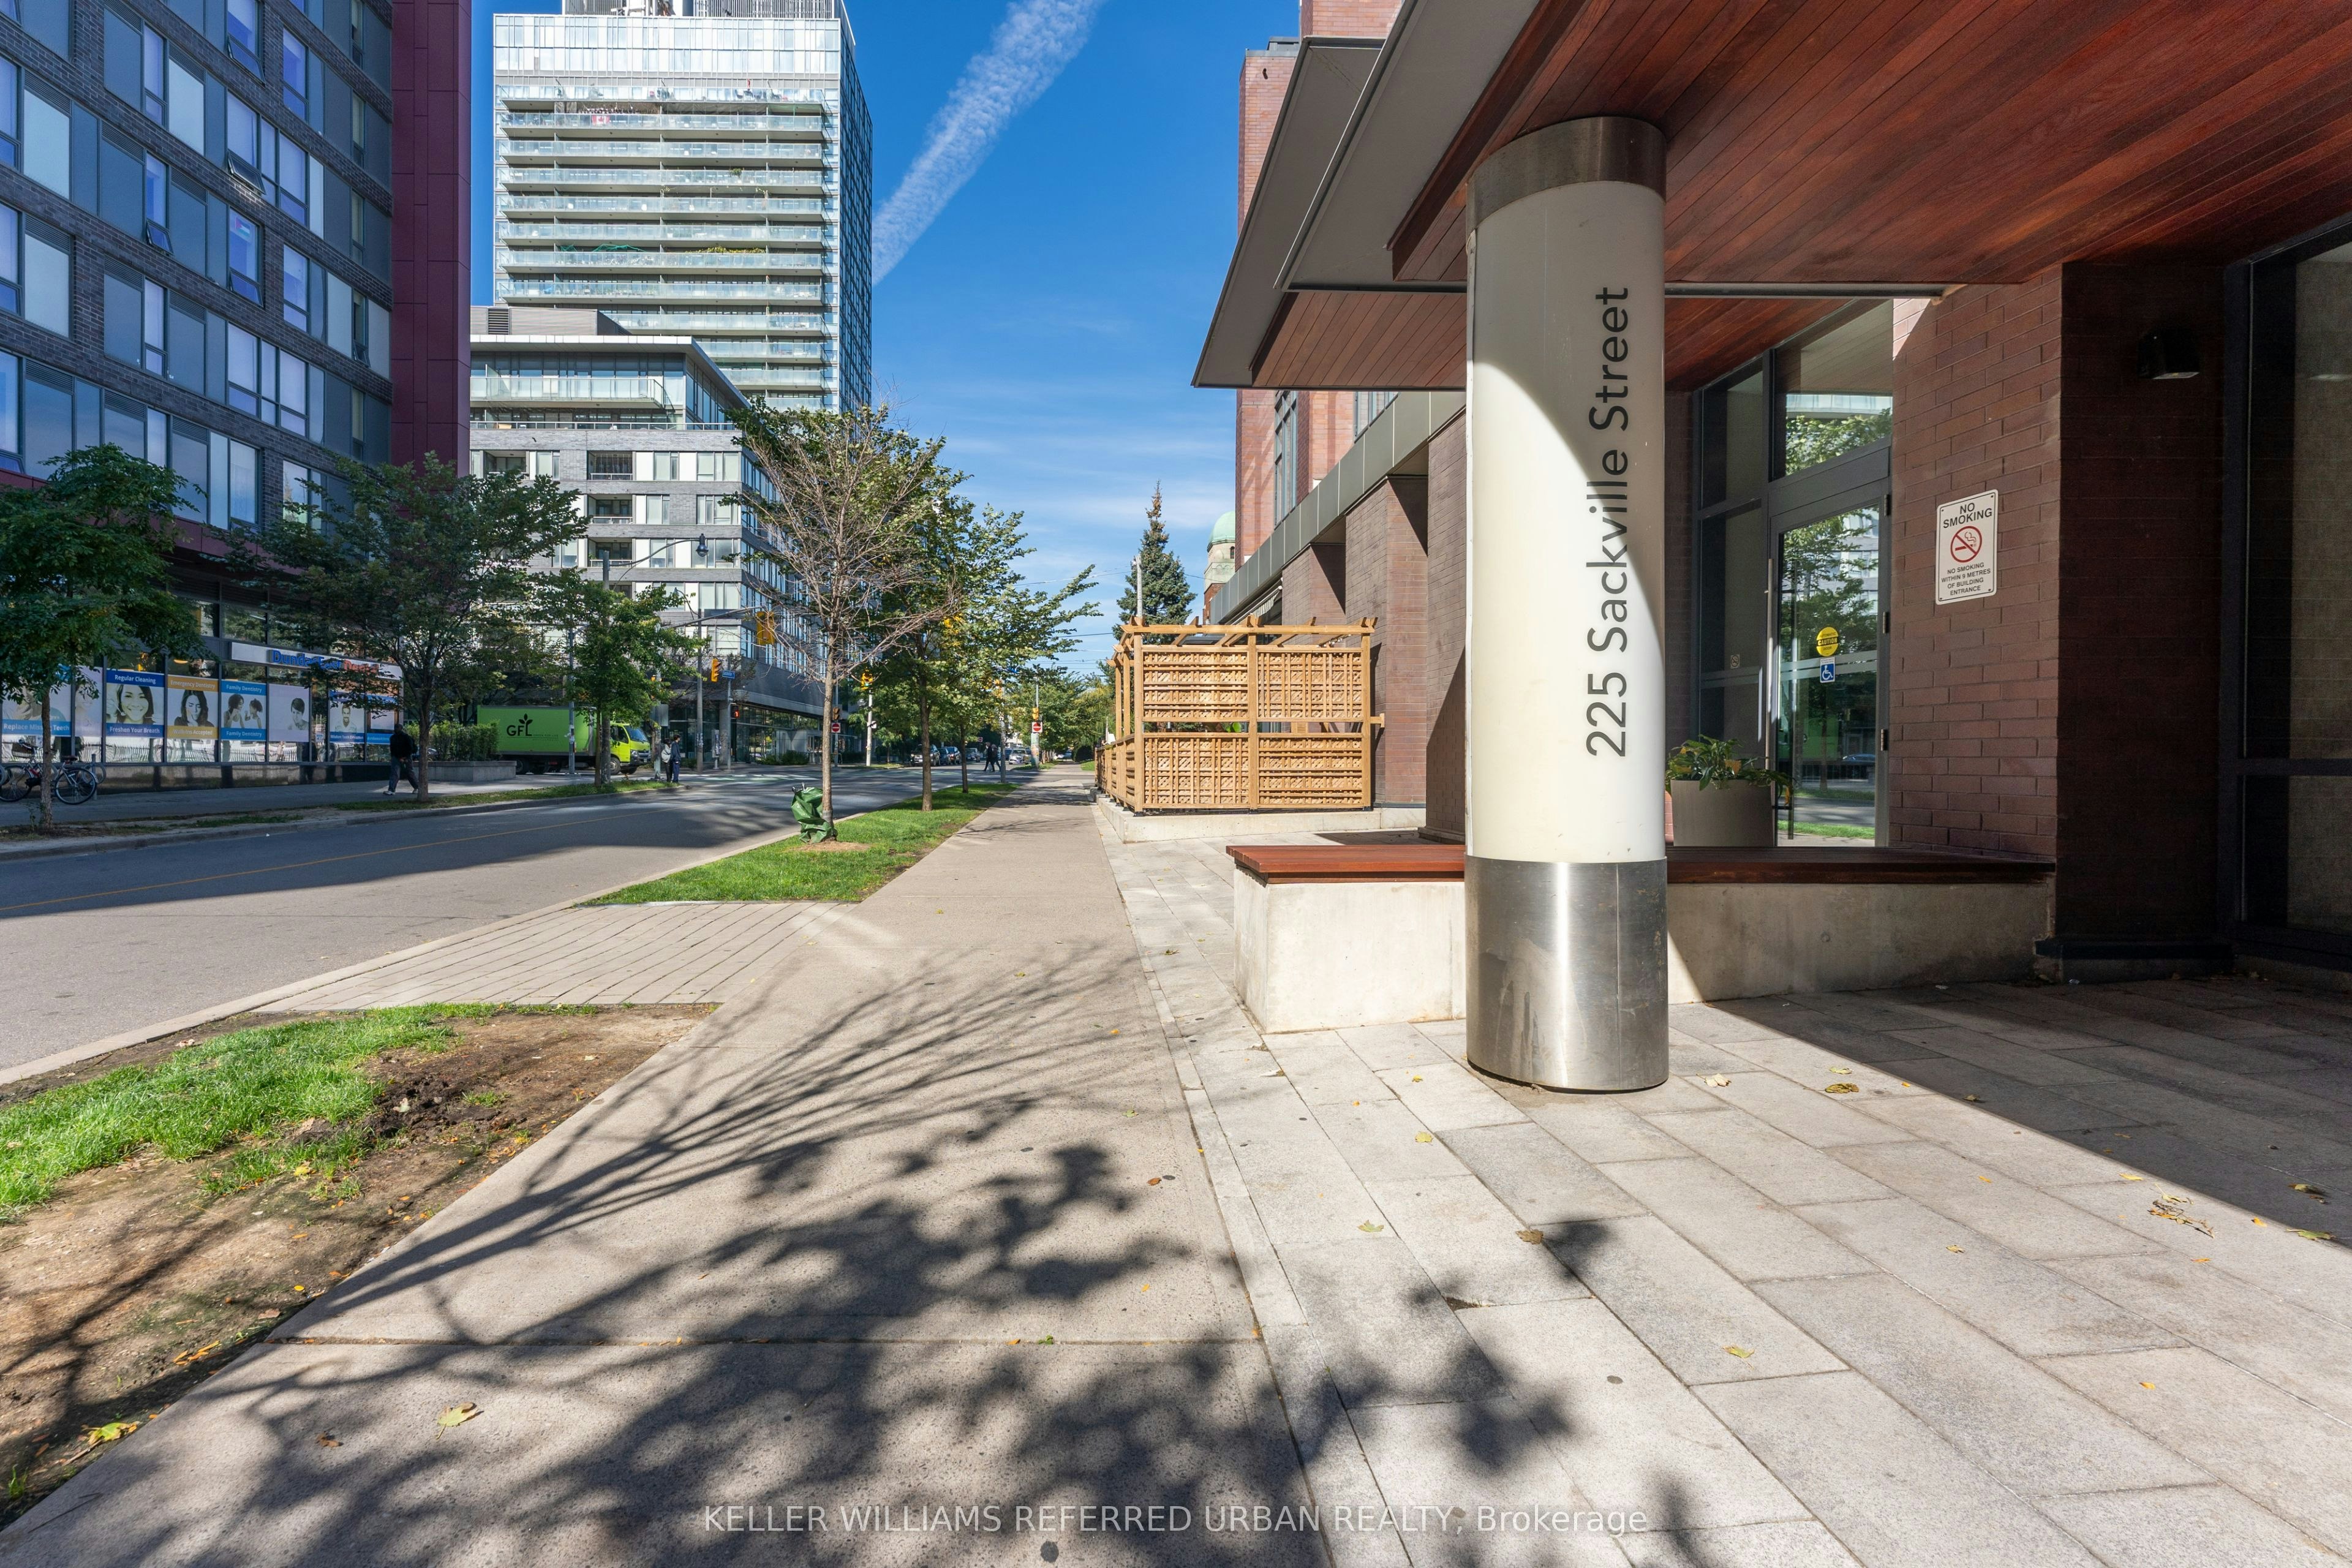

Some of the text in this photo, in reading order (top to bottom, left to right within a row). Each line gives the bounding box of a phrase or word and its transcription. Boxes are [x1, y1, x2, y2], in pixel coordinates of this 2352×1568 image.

[1960, 502, 1975, 514] NO
[1586, 287, 1629, 758] 225 Sackville Street
[1943, 508, 1992, 529] SMOKING
[1957, 562, 1985, 573] SMOKING
[1941, 574, 1961, 583] WITHIN
[1967, 568, 1991, 578] METRES
[1956, 577, 1984, 587] BUILDING
[1950, 586, 1981, 596] ENTRANCE
[1817, 638, 1838, 646] CAUTION
[135, 676, 156, 685] Cleaning
[507, 722, 532, 736] GFL
